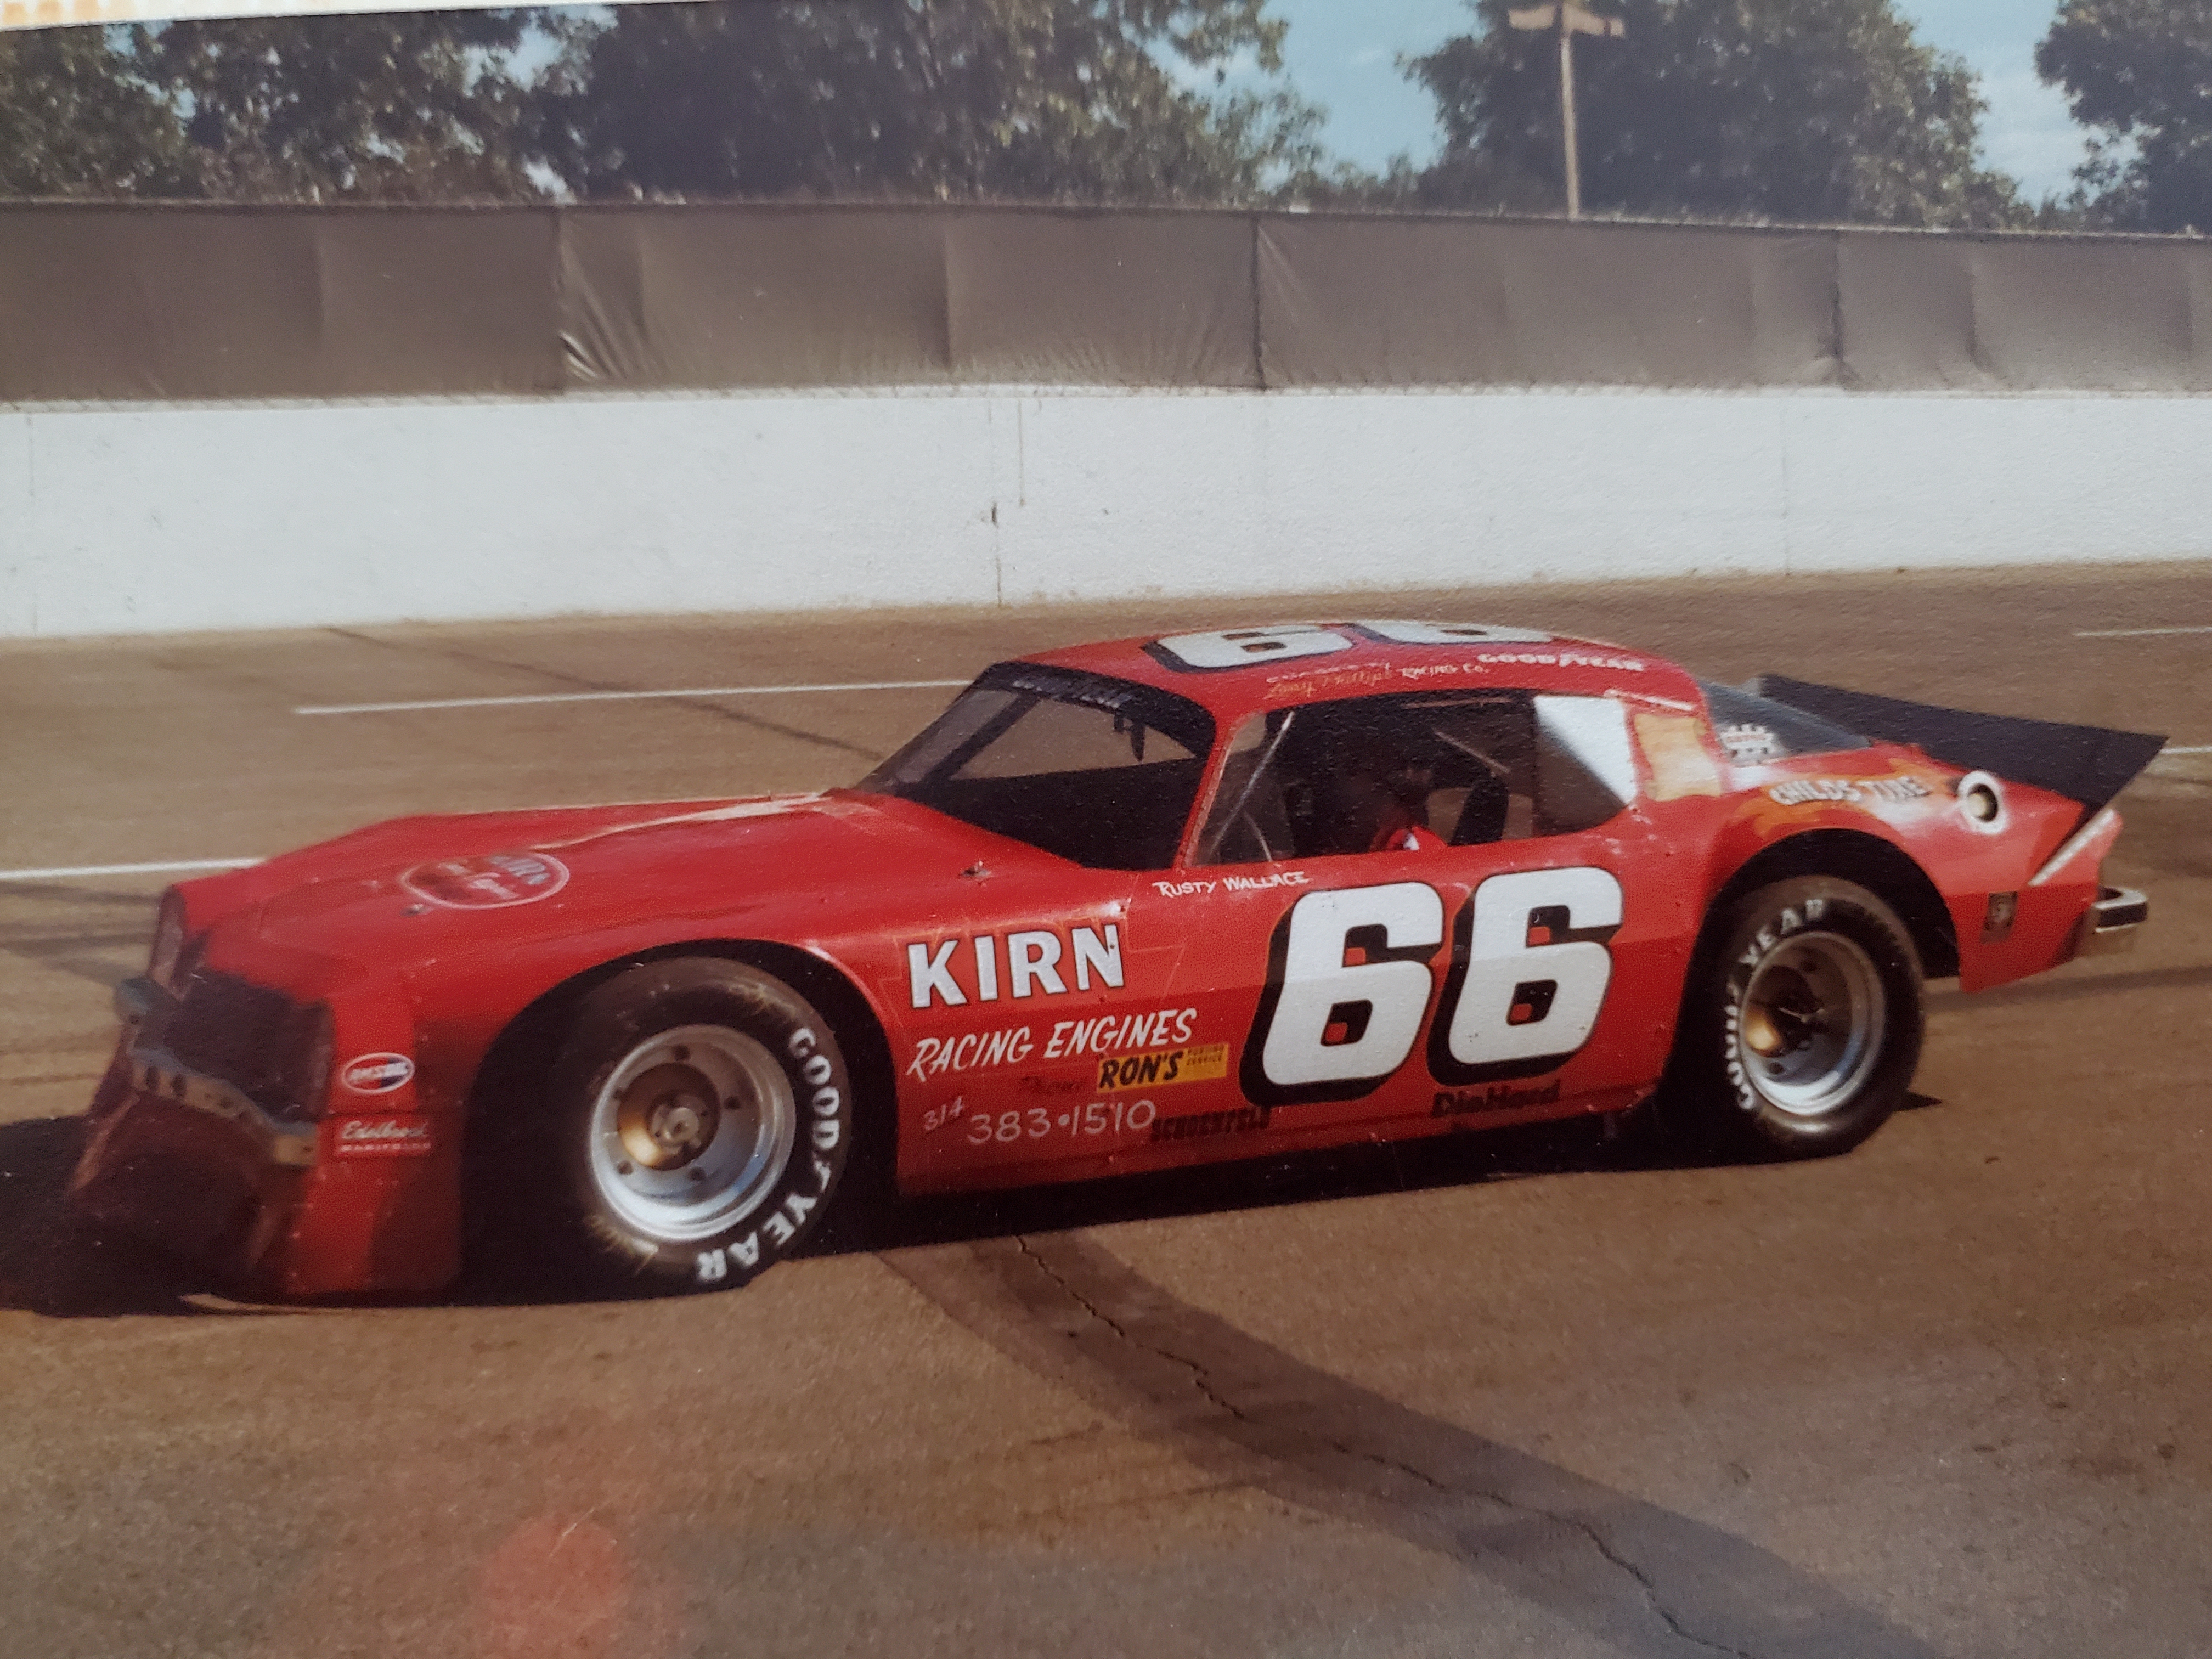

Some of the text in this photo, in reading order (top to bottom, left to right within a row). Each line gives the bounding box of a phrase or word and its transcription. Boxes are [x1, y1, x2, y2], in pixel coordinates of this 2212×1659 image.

[1152, 870, 1310, 898] RUSTY WALLACE
[907, 923, 1125, 1009] KIRN
[1240, 866, 1623, 1106] 66
[906, 1008, 1198, 1082] RACING ENGINES
[1098, 1051, 1184, 1090] RON'S
